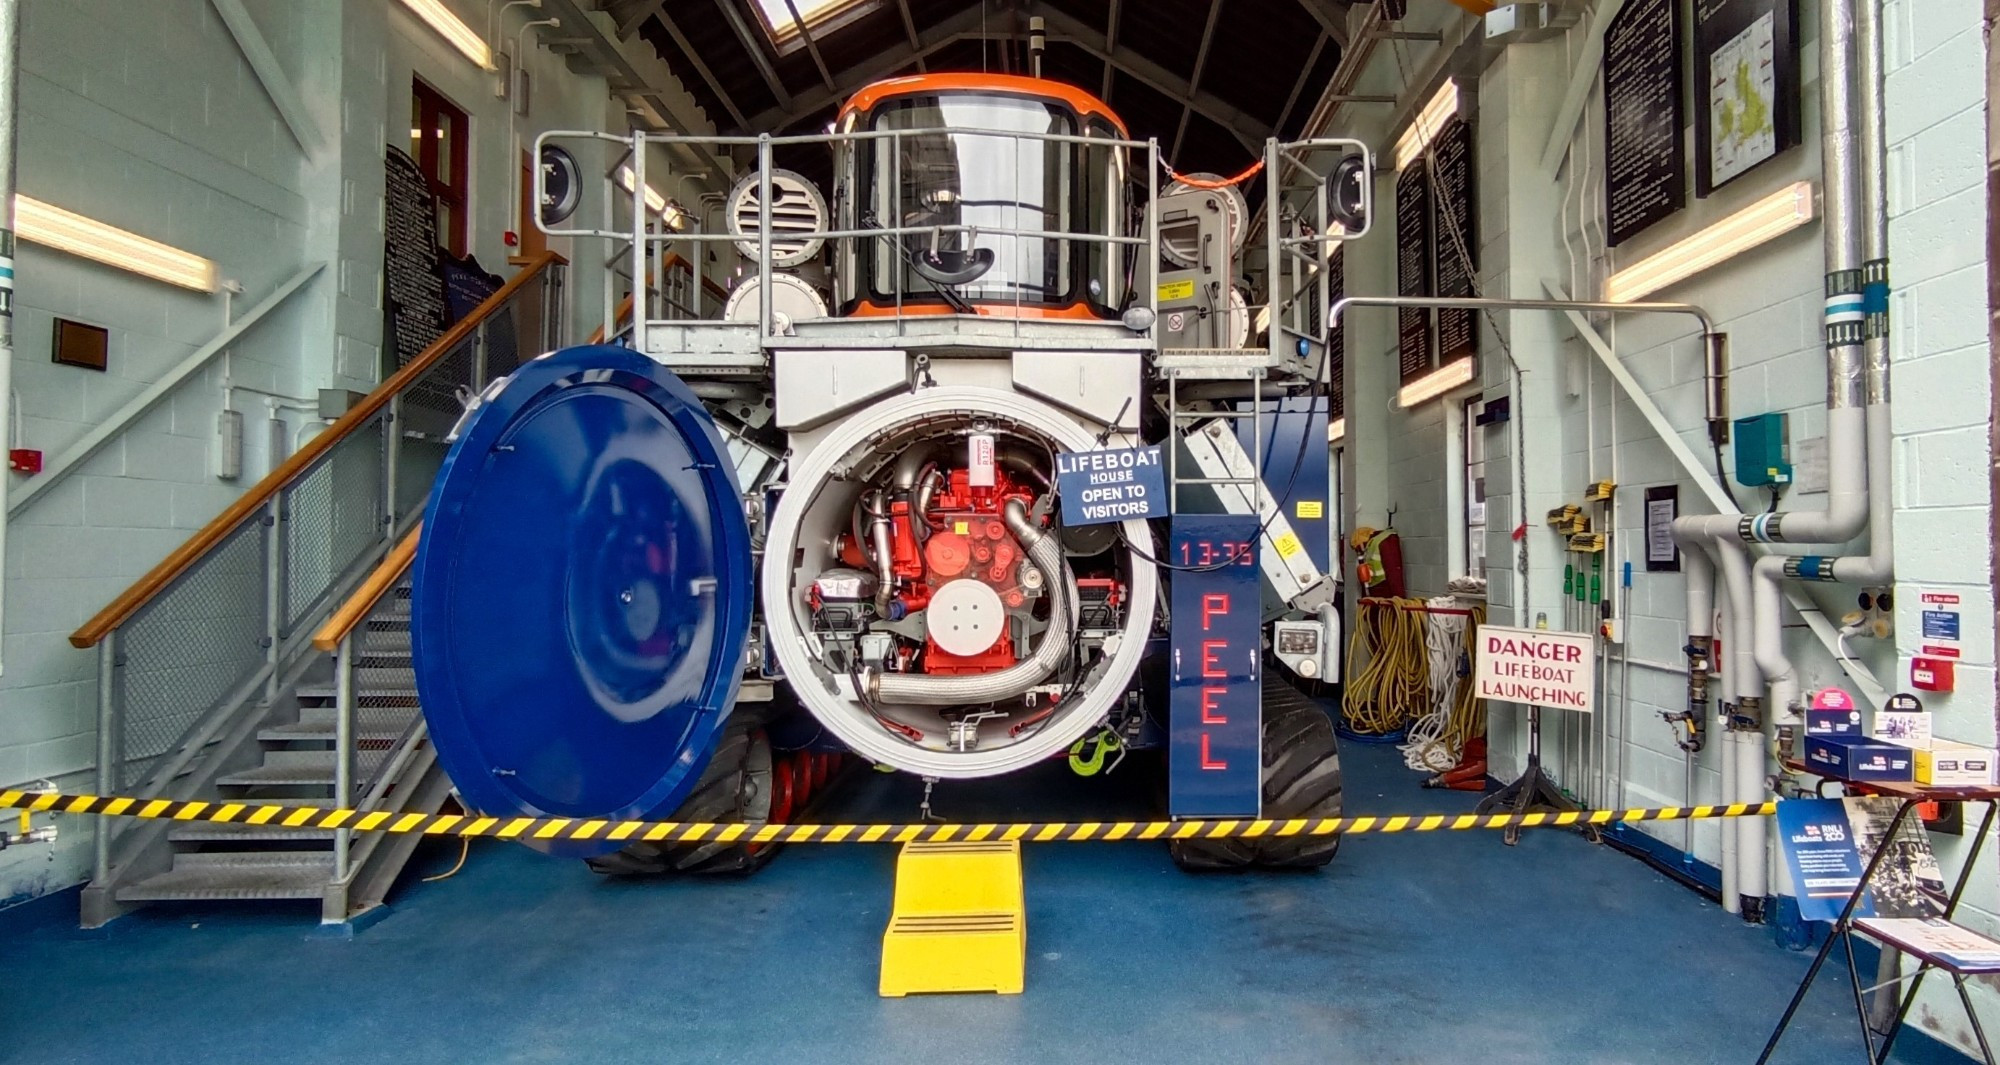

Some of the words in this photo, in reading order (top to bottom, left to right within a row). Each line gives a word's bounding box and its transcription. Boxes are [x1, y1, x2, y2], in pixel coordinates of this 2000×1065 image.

[1058, 450, 1160, 474] LIFEBOAT
[1090, 470, 1134, 484] HOUSE
[1082, 487, 1122, 503] OPEN
[1125, 485, 1146, 498] TO
[1082, 501, 1149, 519] VISITORS
[1488, 637, 1582, 663] DANGER
[1202, 594, 1230, 770] PEEL
[1494, 661, 1575, 684] LIFEBOAT
[1482, 680, 1586, 706] LAUNCHING
[1821, 824, 1843, 833] RNLI
[1823, 832, 1845, 841] 200
